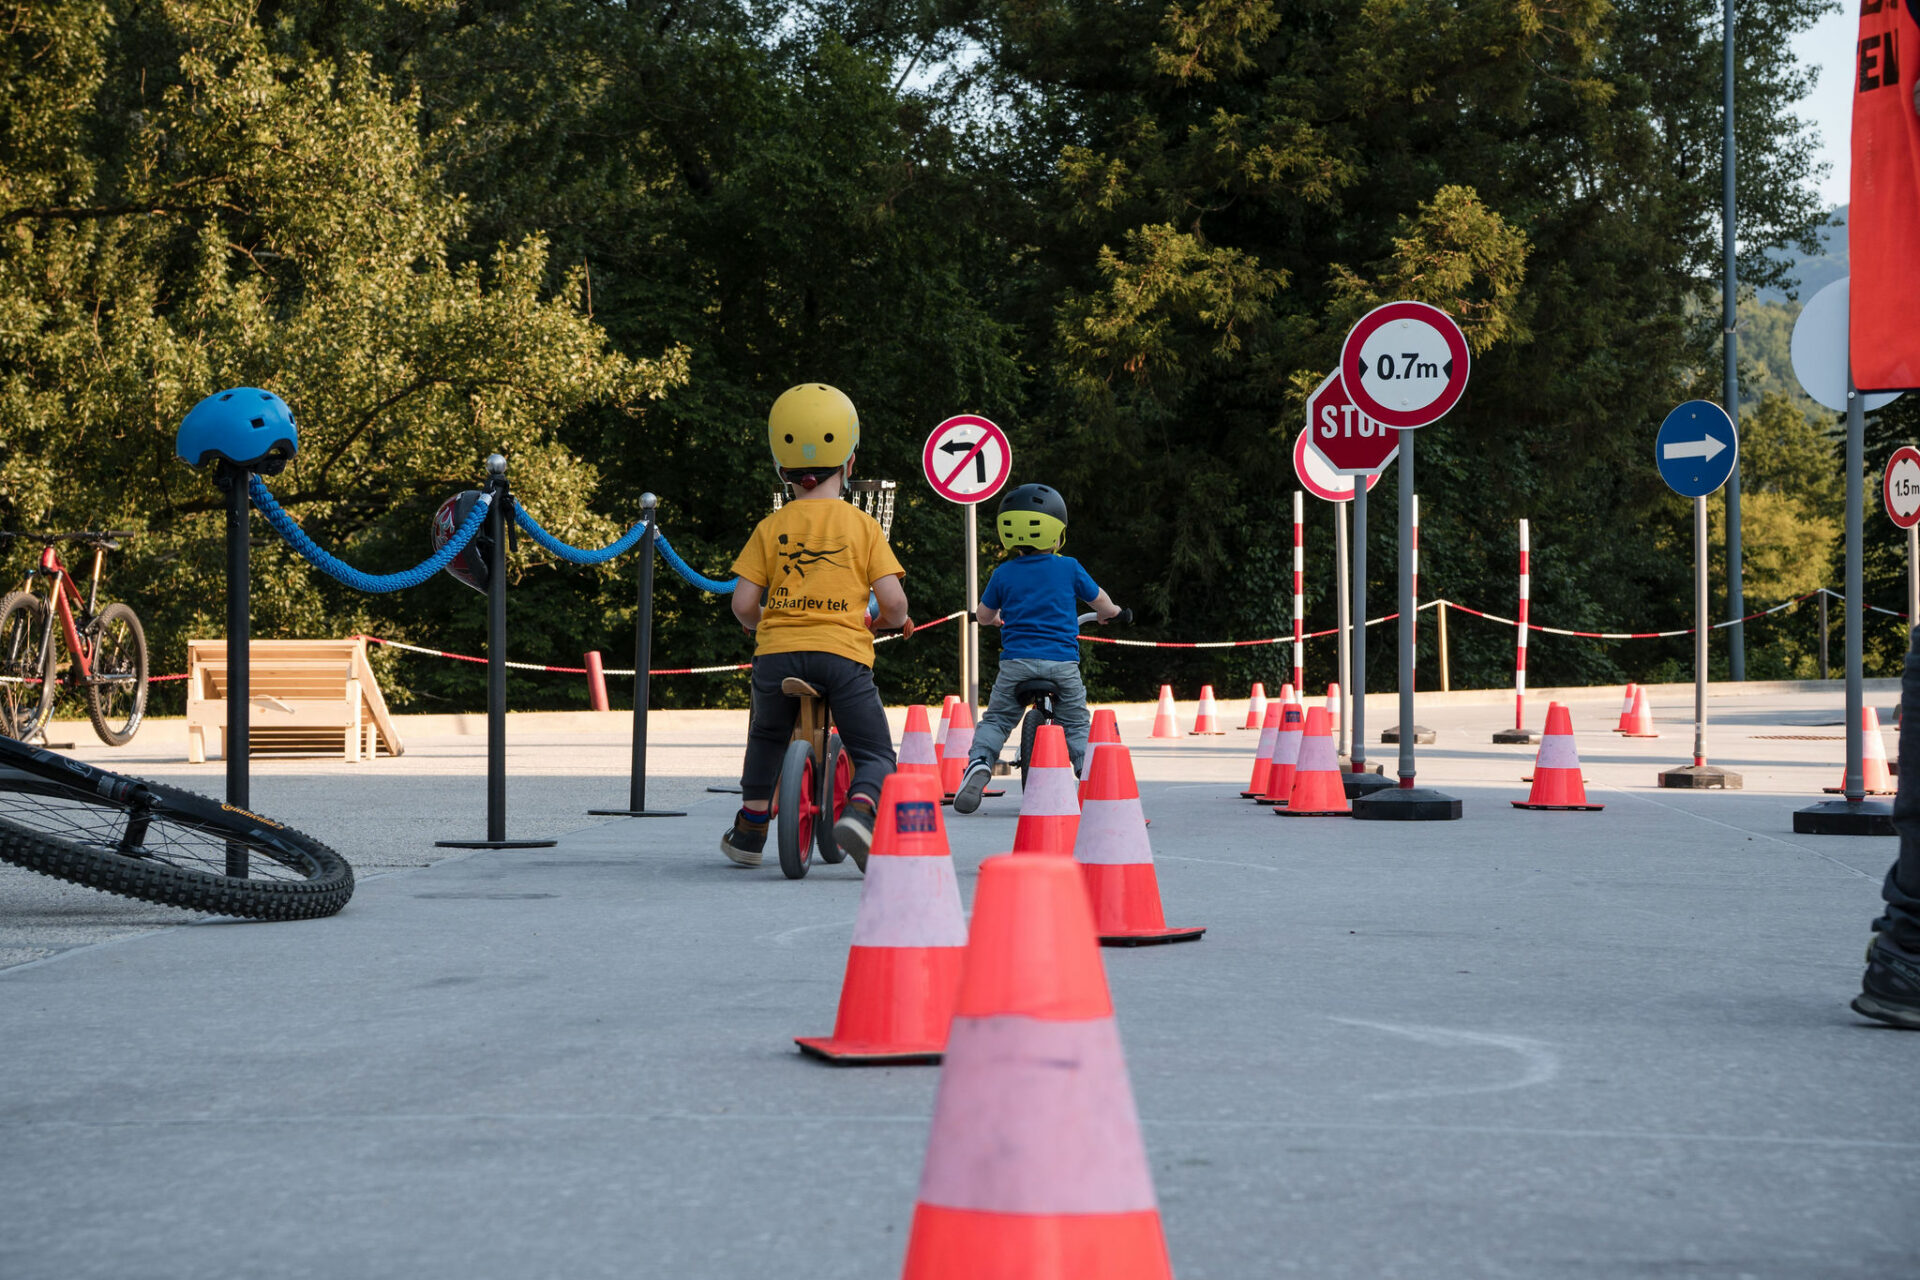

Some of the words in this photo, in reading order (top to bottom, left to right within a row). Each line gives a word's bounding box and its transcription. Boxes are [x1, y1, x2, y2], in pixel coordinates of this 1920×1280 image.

[1377, 352, 1438, 380] 0.7m
[768, 596, 823, 611] Oskarjev
[827, 598, 849, 612] tek
